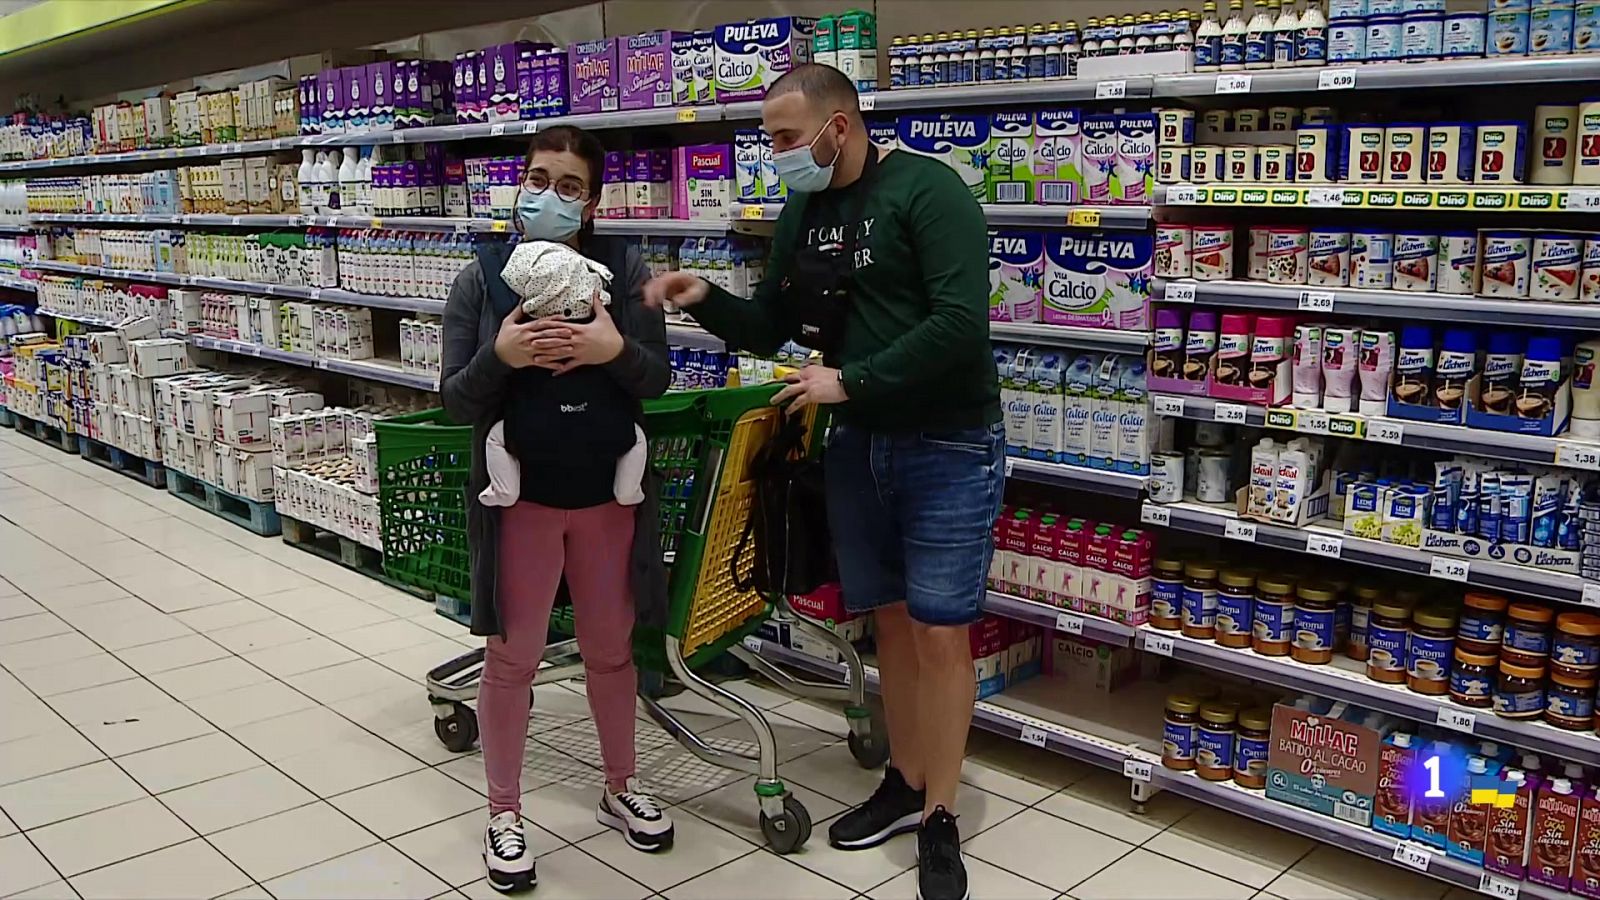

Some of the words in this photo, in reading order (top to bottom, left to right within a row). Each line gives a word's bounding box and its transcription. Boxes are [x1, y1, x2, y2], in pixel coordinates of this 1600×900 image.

[724, 23, 778, 42] PULEVA
[773, 48, 790, 62] Sin
[626, 52, 664, 72] MILLAC
[576, 58, 610, 80] MILLAC
[718, 62, 752, 78] Calcio
[1230, 81, 1246, 89] 1,00
[1334, 76, 1352, 85] 0,99
[1108, 88, 1122, 96] 1,58
[996, 113, 1026, 122] PULEVA
[1042, 111, 1073, 120] PULEVA
[910, 120, 976, 138] PULEVA
[1084, 121, 1114, 130] PULEVA
[1120, 120, 1152, 128] PULEVA
[870, 128, 895, 137] PULEVA
[736, 134, 758, 142] PULEVA
[1084, 142, 1114, 155] Calcio
[1120, 142, 1151, 154] Calcio
[692, 155, 720, 167] Pascual
[700, 190, 712, 198] SIN
[1214, 192, 1234, 201] Dino
[1244, 192, 1264, 201] Dino
[1273, 192, 1296, 202] Dino
[1323, 194, 1340, 202] 1,46
[1344, 194, 1360, 202] ino
[1370, 194, 1394, 204] Dino
[1404, 194, 1428, 204] Dino
[692, 198, 722, 208] LACTOSA
[1440, 195, 1465, 204] Dino
[1476, 196, 1502, 205] Dino
[1521, 196, 1548, 206] Dino
[1060, 237, 1135, 260] PULEVA
[1049, 280, 1096, 300] Calcio
[1008, 402, 1032, 412] Calcio
[1034, 404, 1058, 416] Calcio
[1166, 404, 1180, 412] 2,59
[1066, 408, 1089, 420] Calcio
[1092, 411, 1117, 424] Calcio
[1270, 412, 1291, 424] Dino
[1120, 414, 1144, 427] Calcio
[1310, 420, 1326, 428] 1,55
[1331, 422, 1353, 432] Dino
[1381, 430, 1398, 438] 2,59
[1575, 454, 1596, 462] 1,38
[1253, 464, 1272, 477] ideal
[1279, 466, 1297, 479] ideal
[1006, 538, 1026, 548] CALCIO
[1032, 544, 1052, 553] CALCIO
[1058, 549, 1079, 558] CALCIO
[1086, 554, 1108, 564] CALCIO
[1112, 560, 1133, 570] CALCIO
[1446, 566, 1464, 576] 1,29
[793, 594, 824, 611] Pascual
[1067, 622, 1080, 630] 1,54
[1294, 618, 1324, 630] Caroma
[1058, 642, 1094, 658] CALCIO
[1156, 642, 1170, 651] 1,63
[1412, 646, 1446, 659] Caroma
[1452, 716, 1470, 726] 1,80
[1290, 720, 1358, 758] MILLAC
[1279, 738, 1312, 758] BATIDO
[1314, 750, 1328, 764] AL
[1330, 755, 1366, 774] CACAO
[1273, 774, 1286, 786] 6L
[1539, 798, 1576, 818] MILLAC
[1498, 810, 1518, 822] CACAO
[1498, 819, 1515, 828] Sin
[1544, 820, 1566, 832] CACAO
[1492, 826, 1522, 836] lactosa
[1546, 829, 1562, 838] Sin
[1538, 836, 1570, 846] lactosa
[1409, 854, 1426, 864] 1,73
[1496, 884, 1515, 896] 1,73
